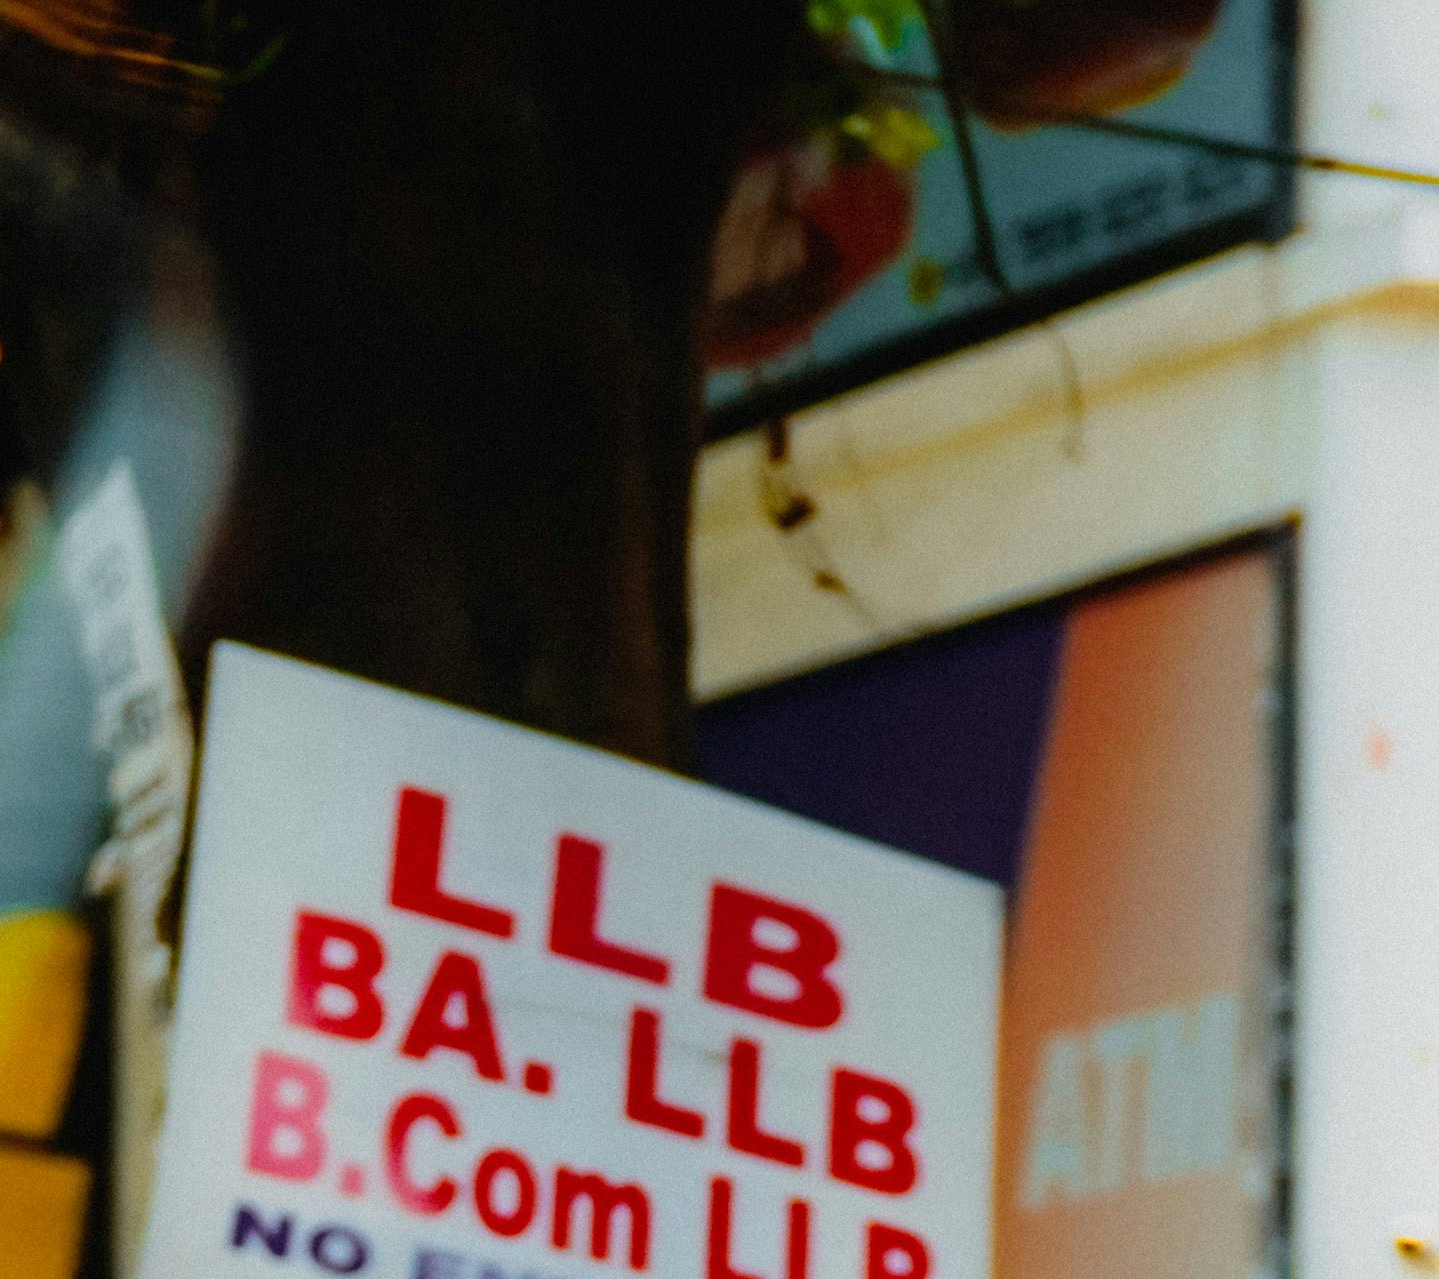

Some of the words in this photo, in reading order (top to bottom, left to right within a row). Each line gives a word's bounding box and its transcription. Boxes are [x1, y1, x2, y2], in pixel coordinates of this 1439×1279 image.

[387, 783, 845, 1032] LLB
[243, 1048, 655, 1274] B.Com
[285, 907, 555, 1097] BA.
[623, 1004, 920, 1197] LLB
[1019, 990, 1236, 1208] ATM
[229, 1202, 375, 1279] NO
